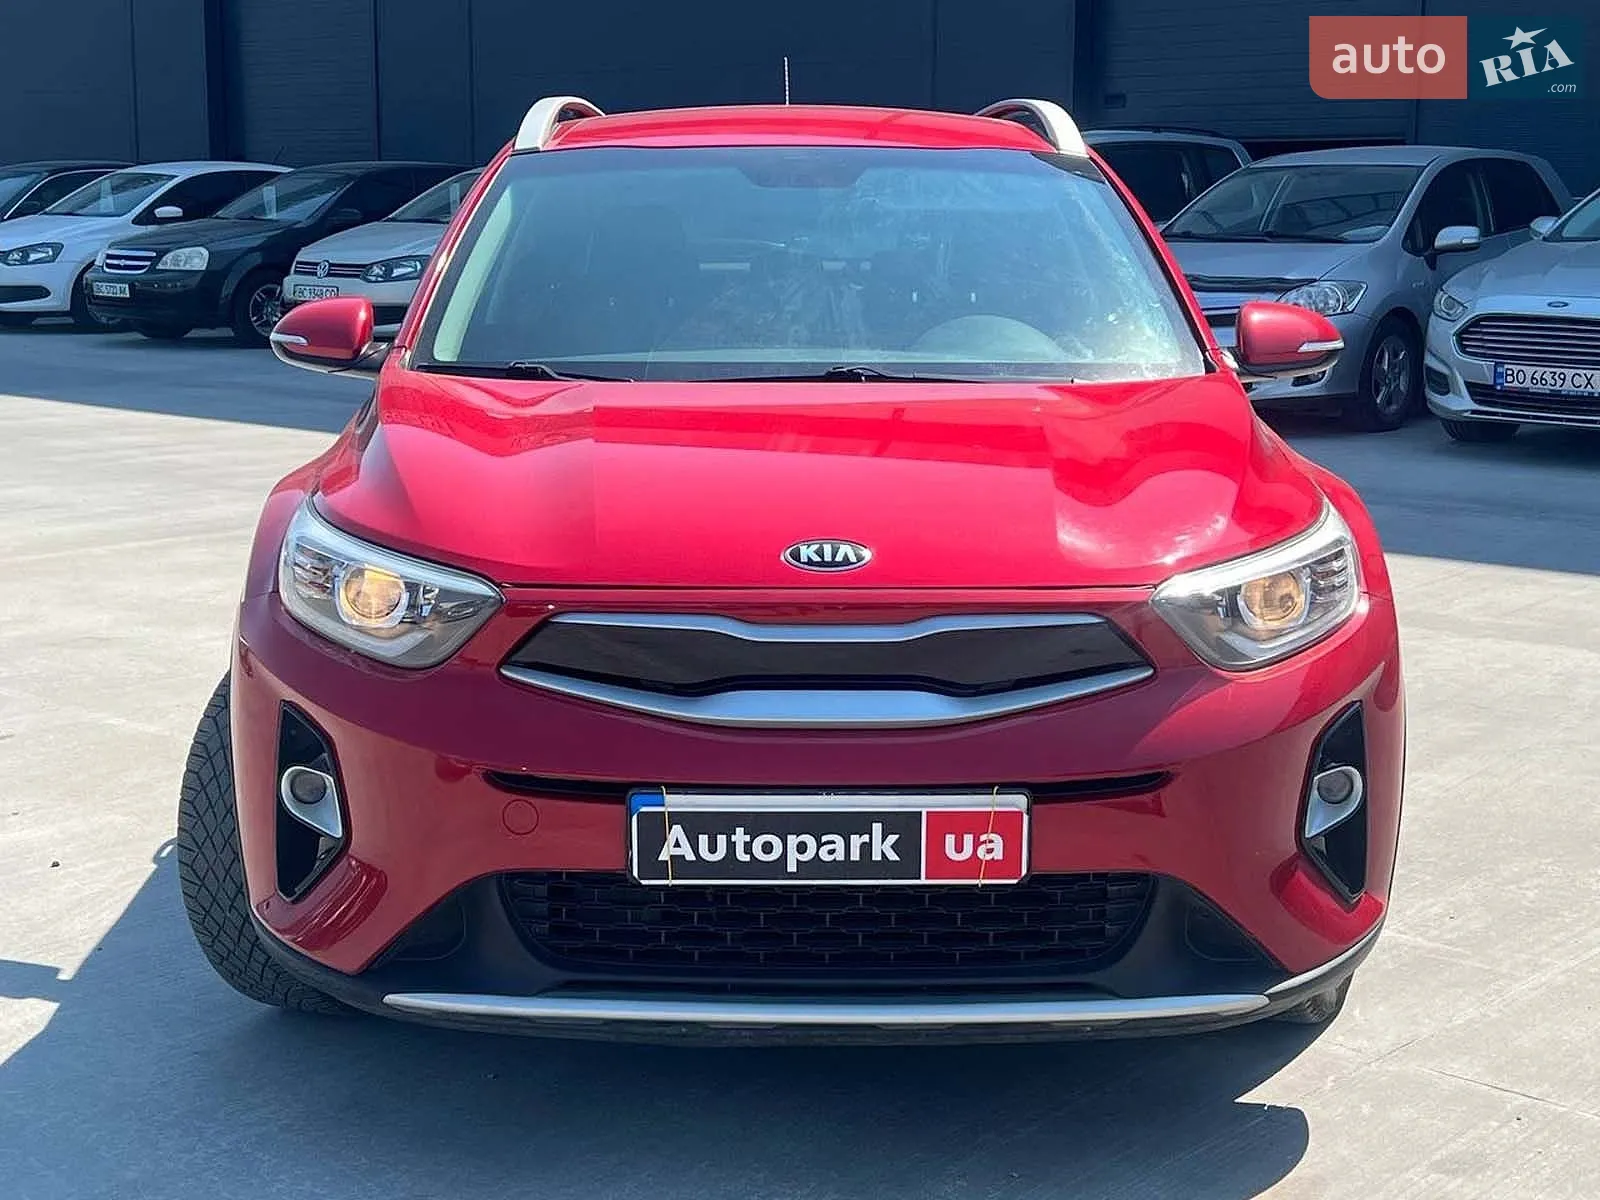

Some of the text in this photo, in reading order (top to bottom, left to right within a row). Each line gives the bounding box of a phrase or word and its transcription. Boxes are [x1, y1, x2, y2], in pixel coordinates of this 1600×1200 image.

[1504, 368, 1594, 389] BO 6639 CX
[799, 543, 857, 562] KIA
[657, 822, 1004, 872] Autopark ua
